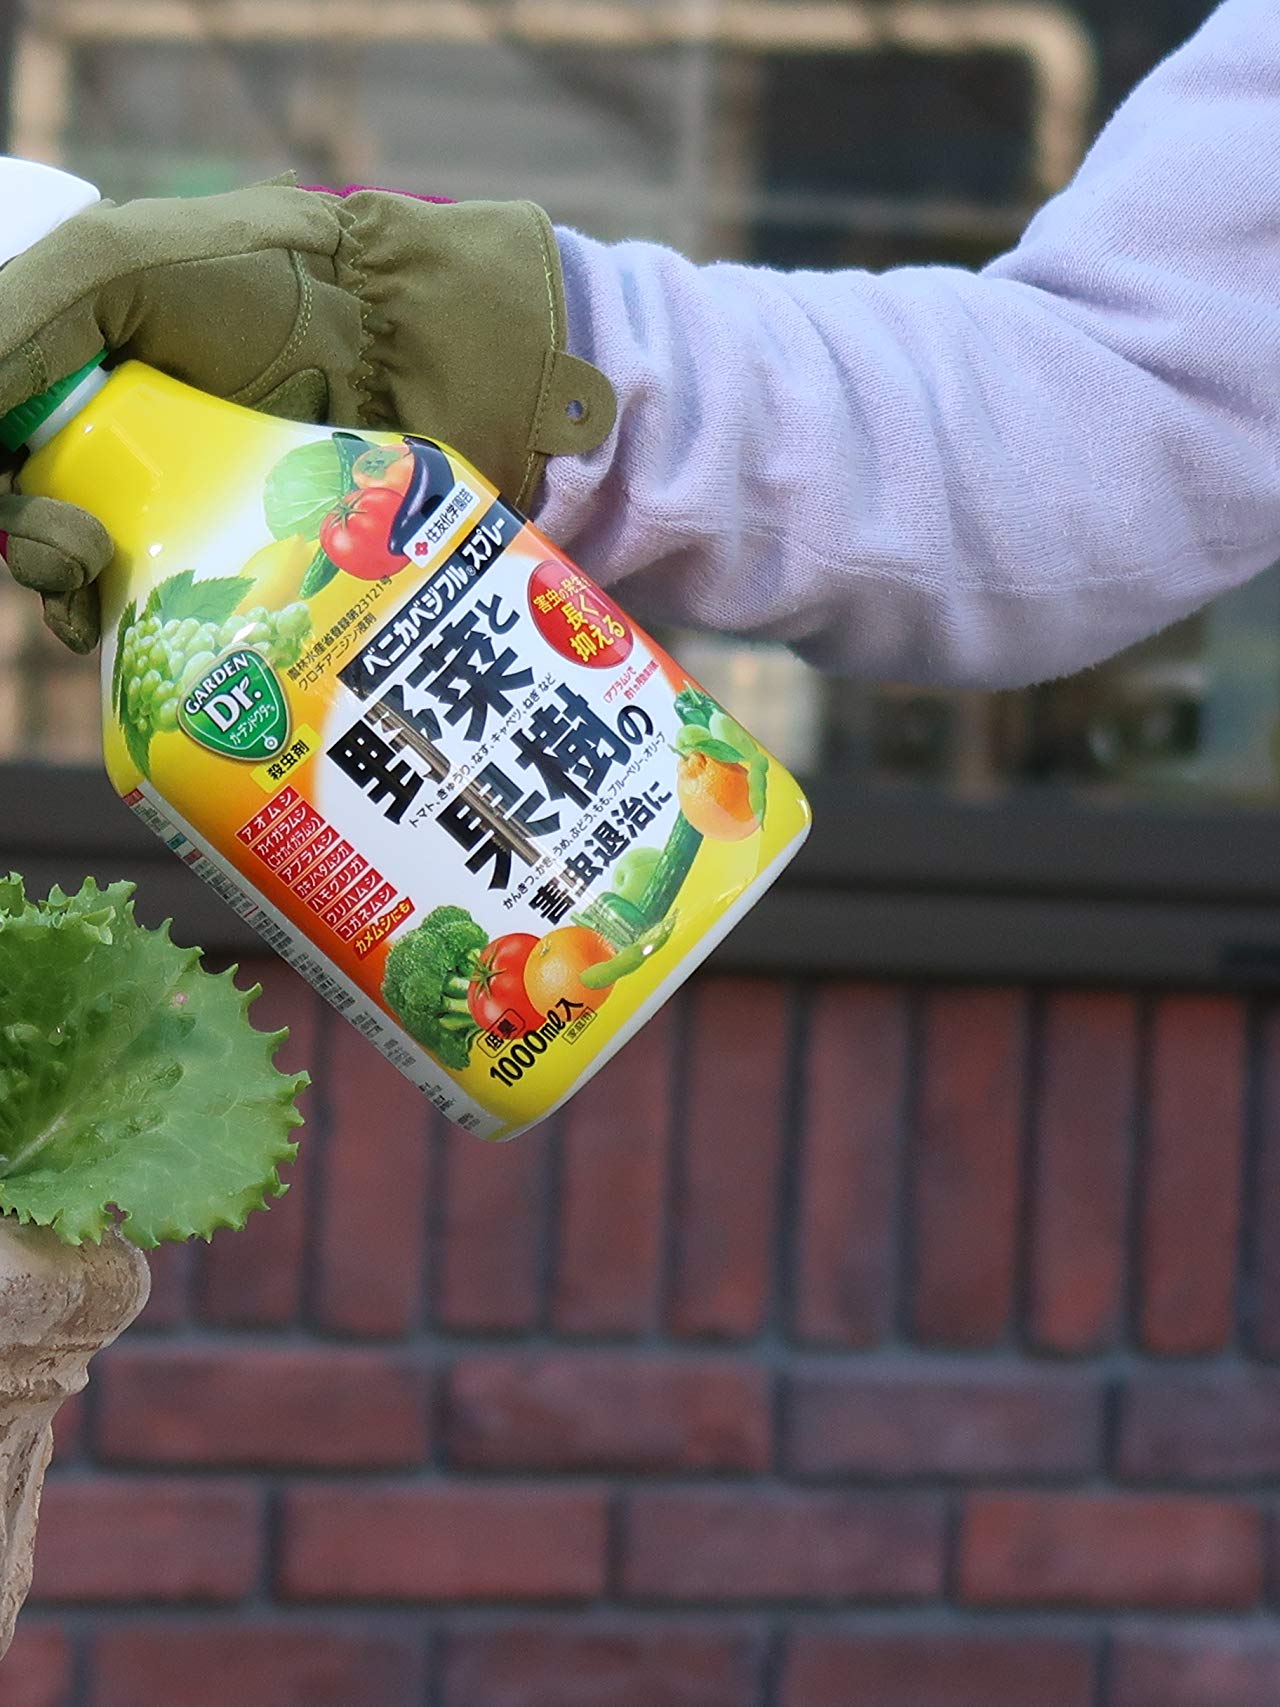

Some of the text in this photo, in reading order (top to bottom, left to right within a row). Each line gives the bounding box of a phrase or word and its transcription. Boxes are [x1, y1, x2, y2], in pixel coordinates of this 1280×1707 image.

[424, 488, 473, 543] 住友化学園芸
[561, 593, 599, 630] 長く
[298, 611, 376, 690] クロチアニジン液剤
[569, 614, 624, 661] 抑える
[185, 653, 249, 714] GARDEN
[203, 677, 261, 731] Dr.
[325, 593, 540, 824] 野菜と
[266, 739, 309, 779] 殺虫剤
[434, 682, 653, 890] 果樹の
[241, 792, 291, 840] アオムシ
[257, 806, 305, 855] カイガラムシ
[267, 817, 320, 867] (コナカイガラムシ)
[281, 831, 332, 880] アブラムシ
[528, 781, 672, 925] 害虫退治に
[297, 843, 349, 895] カキノヘタムシガ
[311, 857, 363, 909] ハモグリガ
[326, 874, 375, 923] ウリハムシ
[340, 888, 389, 937] コガネムシ
[355, 898, 409, 953] カメムシにも
[484, 1018, 518, 1051] 低臭
